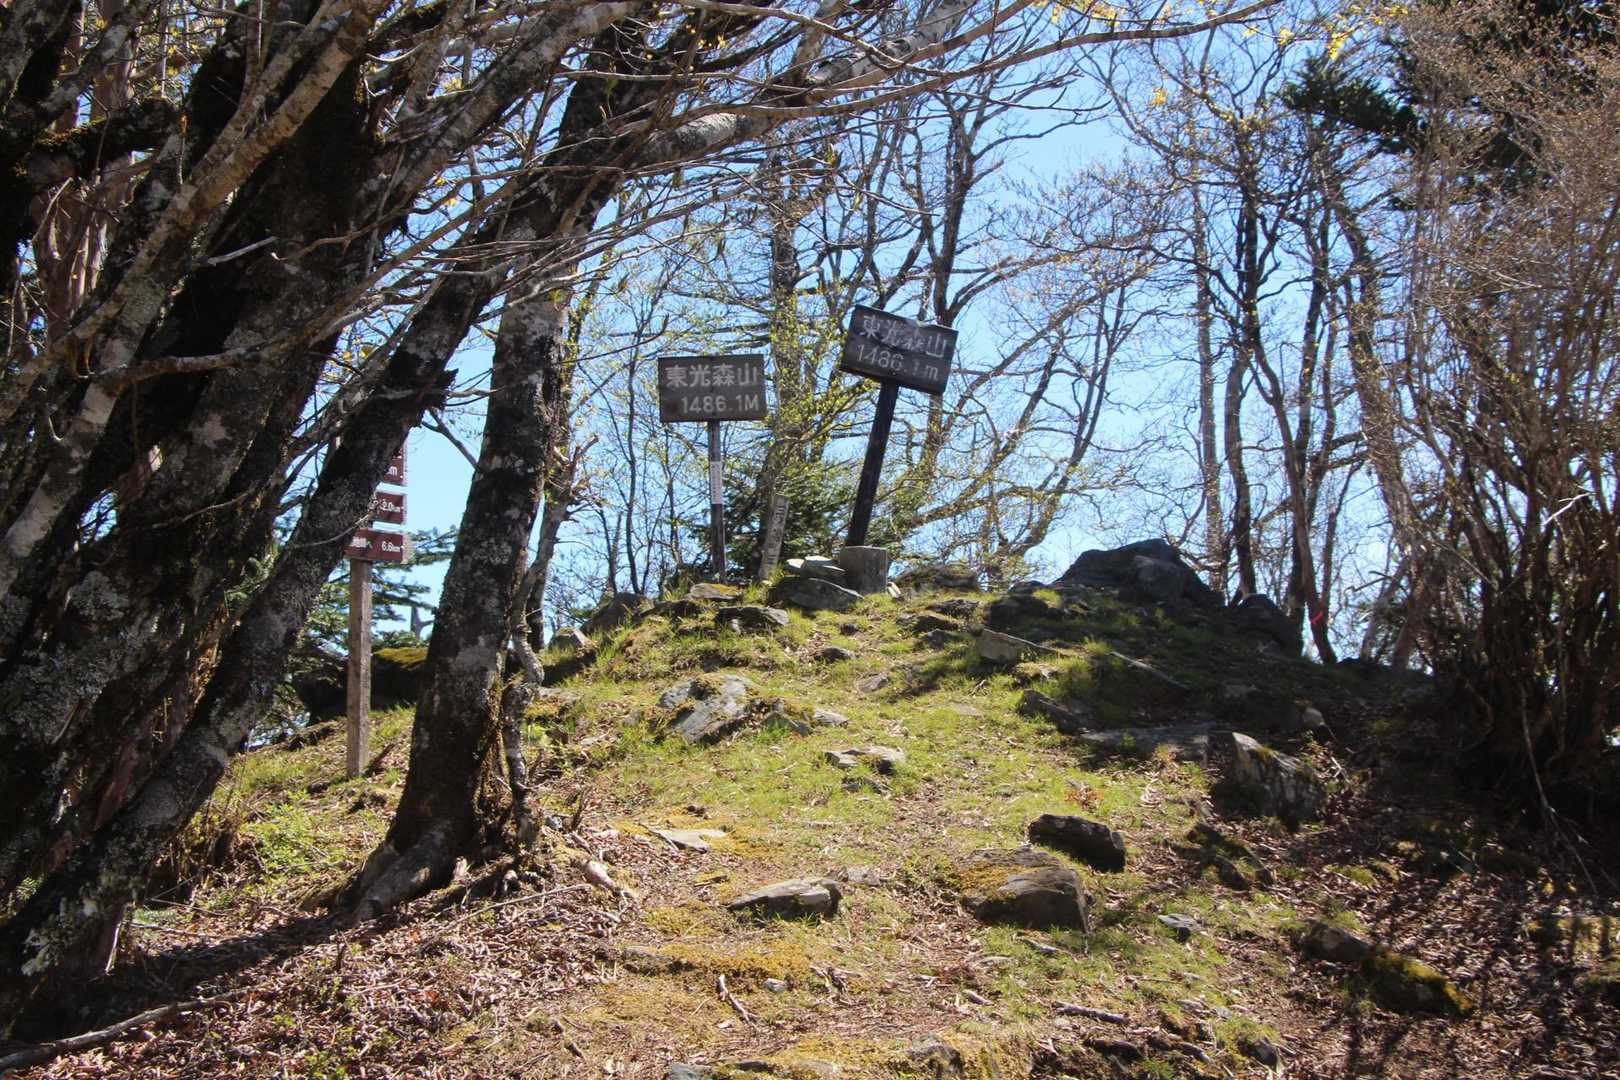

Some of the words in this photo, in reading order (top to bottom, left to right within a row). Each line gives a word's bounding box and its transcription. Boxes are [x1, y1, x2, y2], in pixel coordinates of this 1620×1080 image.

[664, 362, 759, 387] 東光森山
[681, 394, 760, 414] 1486.1M
